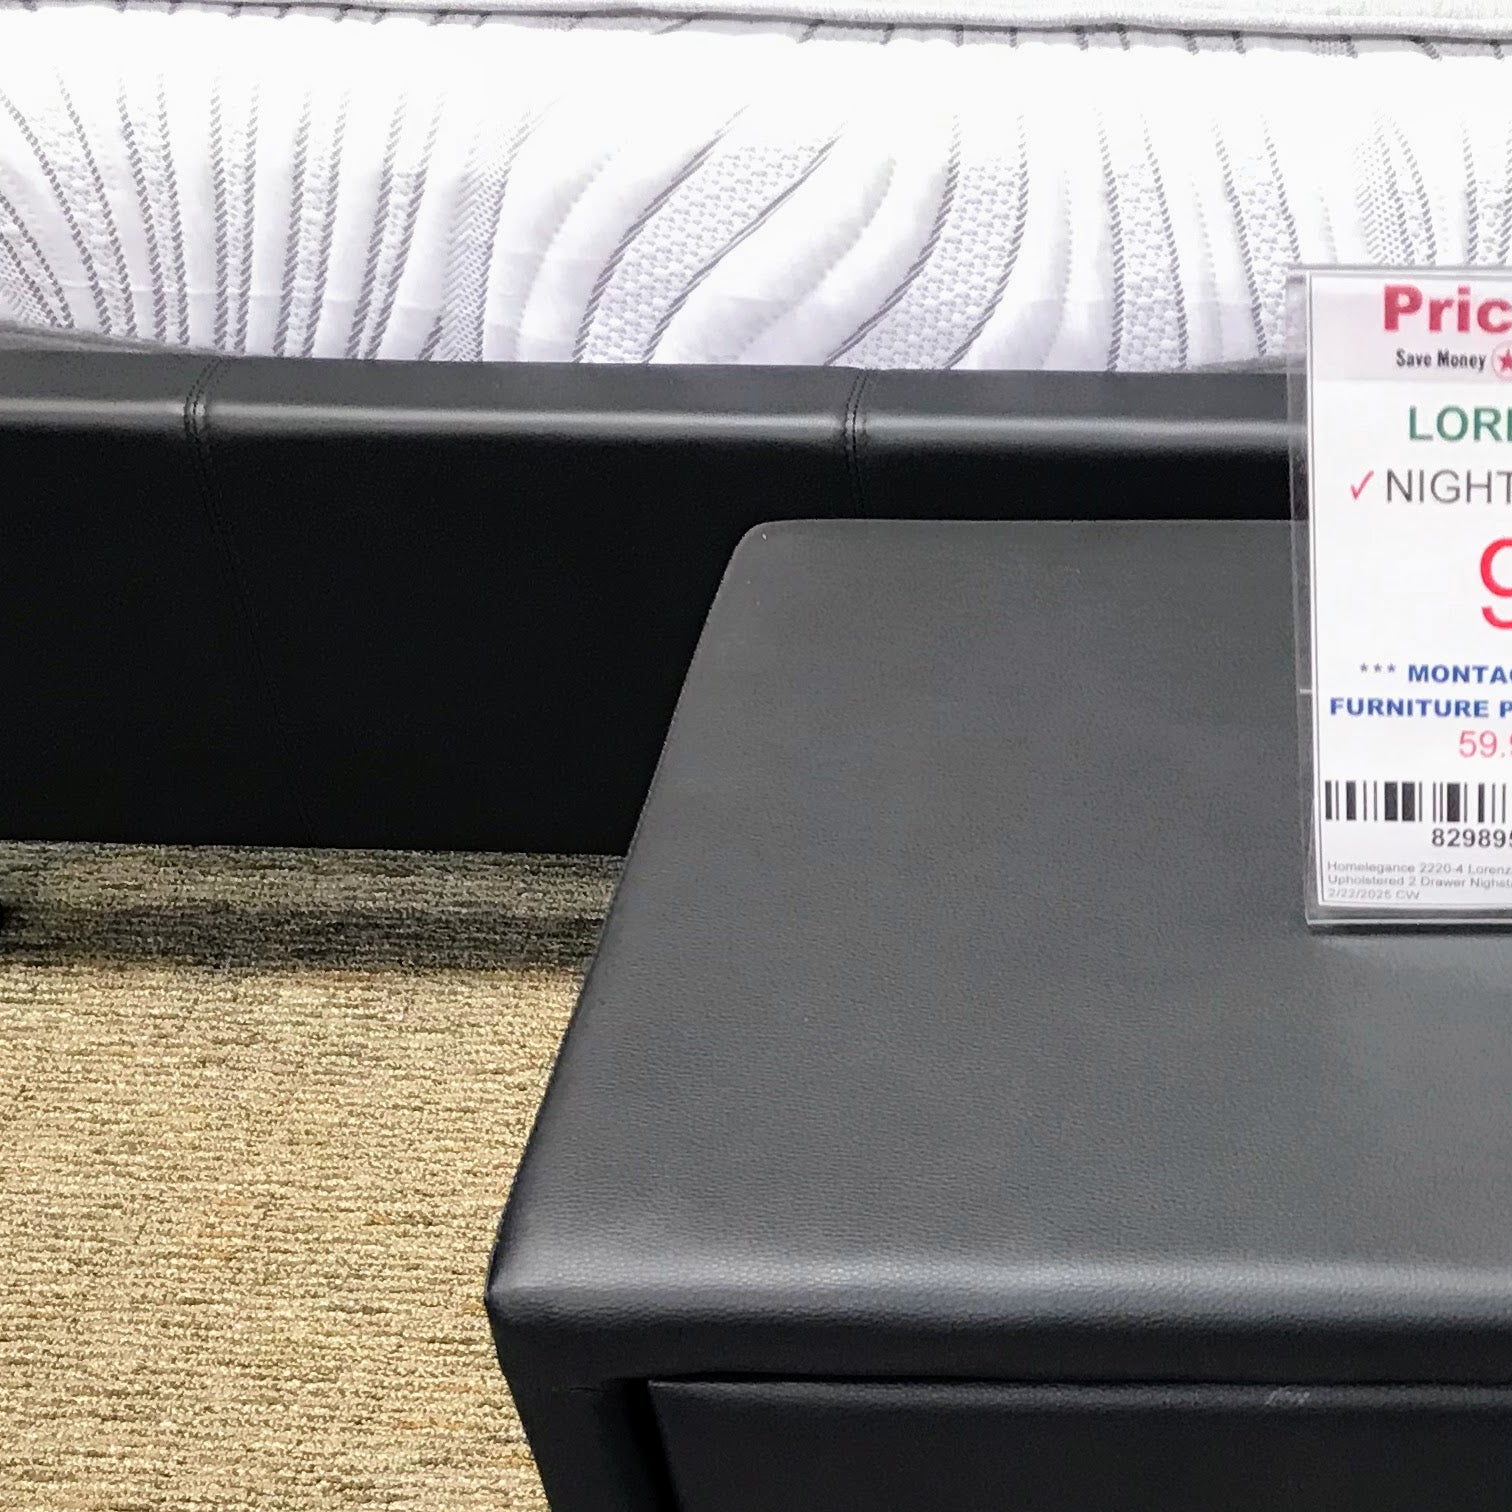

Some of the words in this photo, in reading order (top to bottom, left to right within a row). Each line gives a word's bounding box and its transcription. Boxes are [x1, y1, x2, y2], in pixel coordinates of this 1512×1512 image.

[1396, 349, 1431, 368] Save
[1437, 350, 1486, 371] Money
[1329, 697, 1490, 718] FURNITURE
[1327, 861, 1415, 874] Homelegance
[1328, 874, 1405, 888] Upholstered
[1409, 877, 1417, 886] 2
[1420, 878, 1465, 888] Drawer
[1396, 889, 1420, 900] CW
